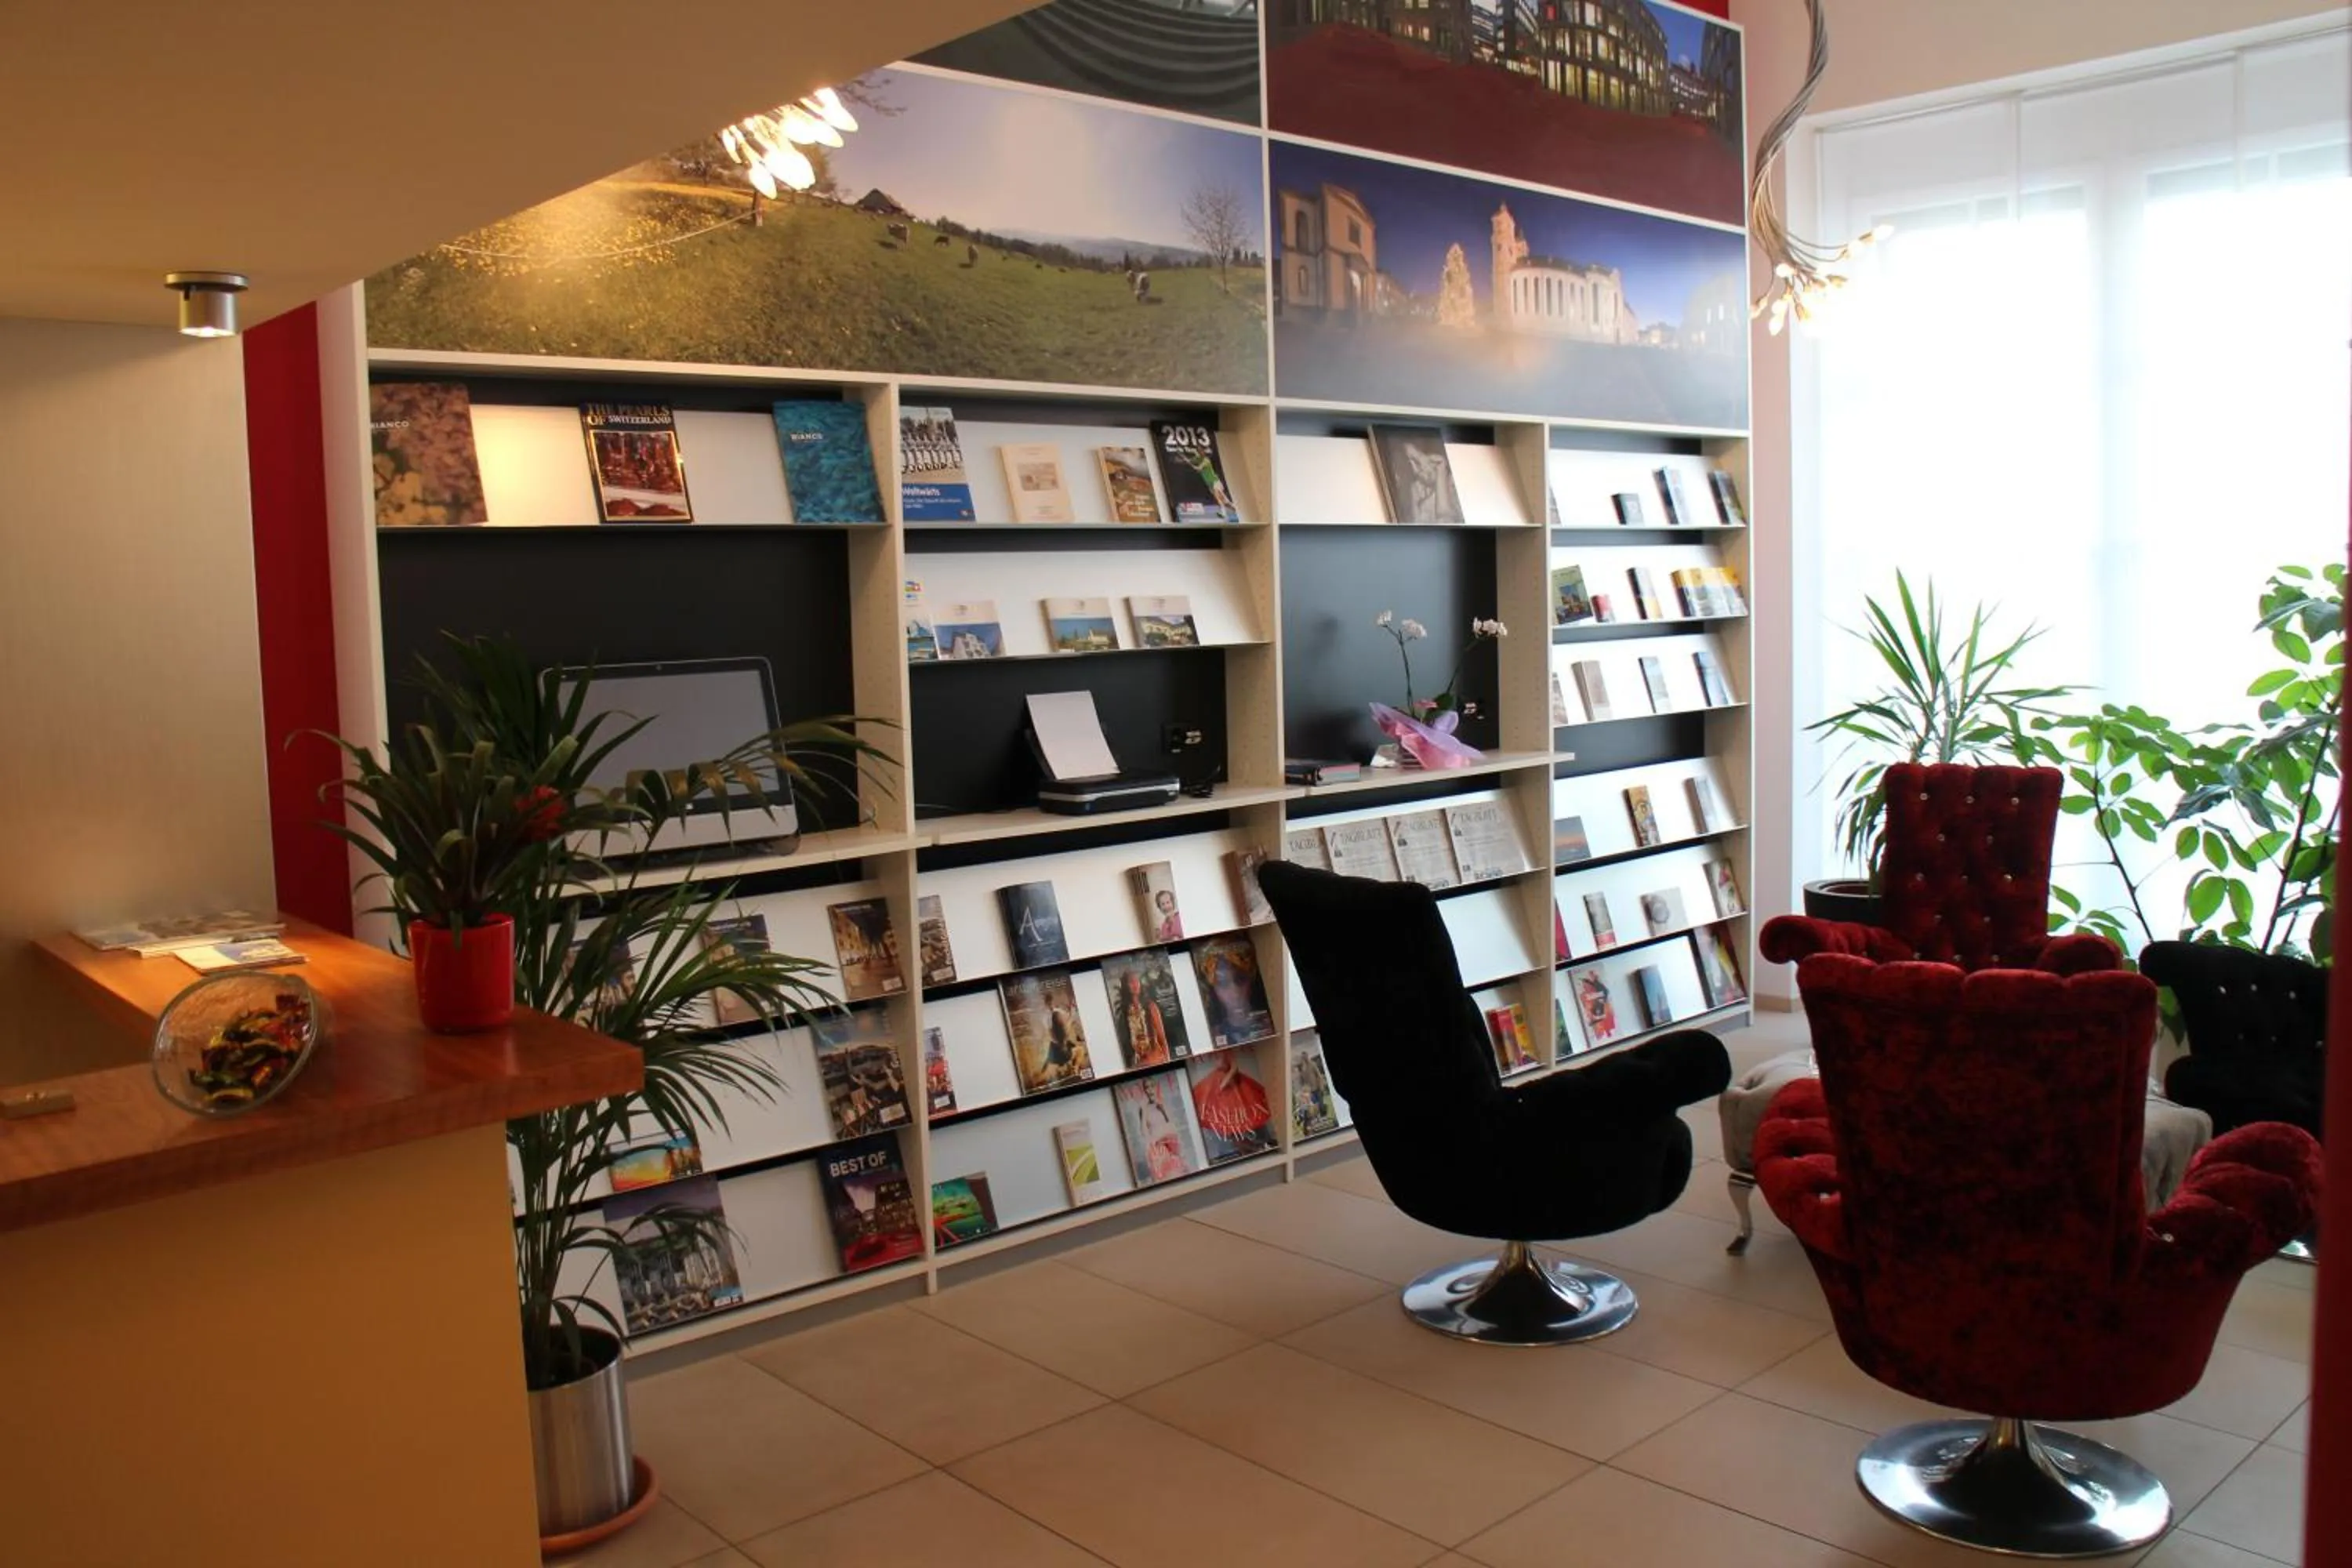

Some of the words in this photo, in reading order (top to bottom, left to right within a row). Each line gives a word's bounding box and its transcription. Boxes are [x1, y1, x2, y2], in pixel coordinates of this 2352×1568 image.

[608, 414, 672, 424] SWITZERLAND
[1162, 426, 1211, 447] 2013
[1200, 1103, 1270, 1124] FASHION
[1209, 1122, 1256, 1142] NEWS
[829, 1156, 866, 1178] BEST
[868, 1150, 887, 1167] OF
